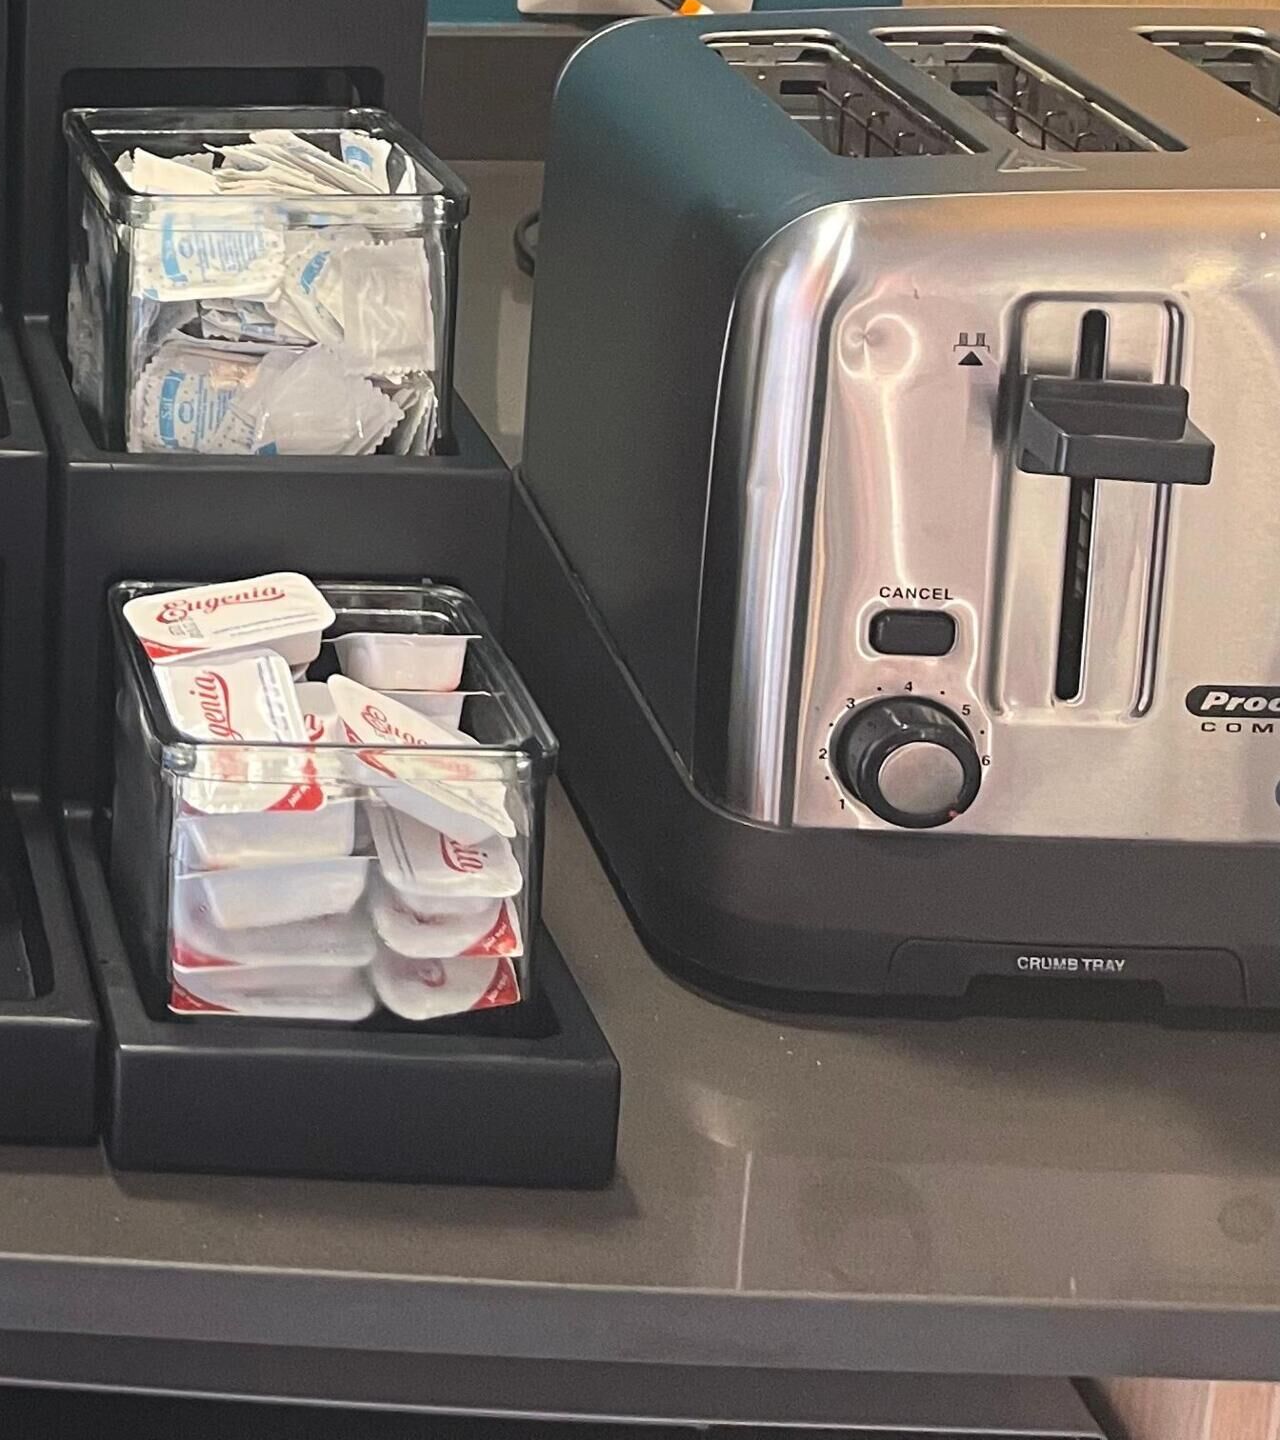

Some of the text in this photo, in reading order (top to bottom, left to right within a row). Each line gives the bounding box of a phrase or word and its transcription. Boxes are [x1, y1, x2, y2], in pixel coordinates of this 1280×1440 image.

[879, 586, 954, 601] CANCEL
[155, 586, 286, 624] Eugenia
[904, 681, 913, 692] 4
[846, 698, 855, 709] 3
[962, 704, 971, 716] 5
[1200, 722, 1274, 734] COM
[818, 748, 828, 759] 2
[982, 755, 991, 766] 6
[839, 799, 845, 809] 1
[1017, 956, 1126, 972] CRUMB TRAY
